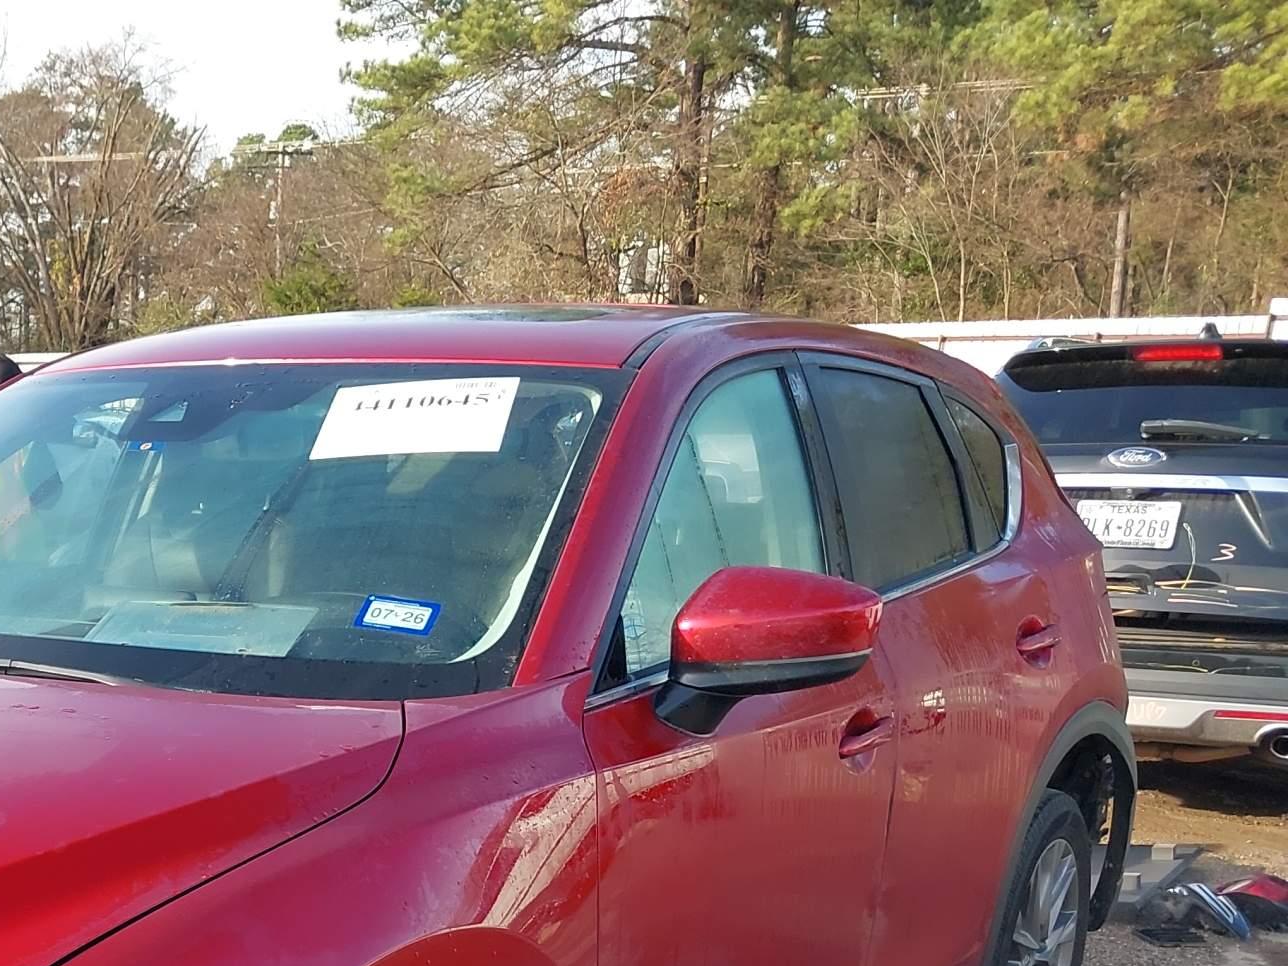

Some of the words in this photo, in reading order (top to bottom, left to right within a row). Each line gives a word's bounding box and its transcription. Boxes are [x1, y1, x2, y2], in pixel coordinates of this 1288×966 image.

[1119, 450, 1152, 463] Ford
[1111, 505, 1148, 514] TEXAS
[1211, 543, 1237, 561] 3
